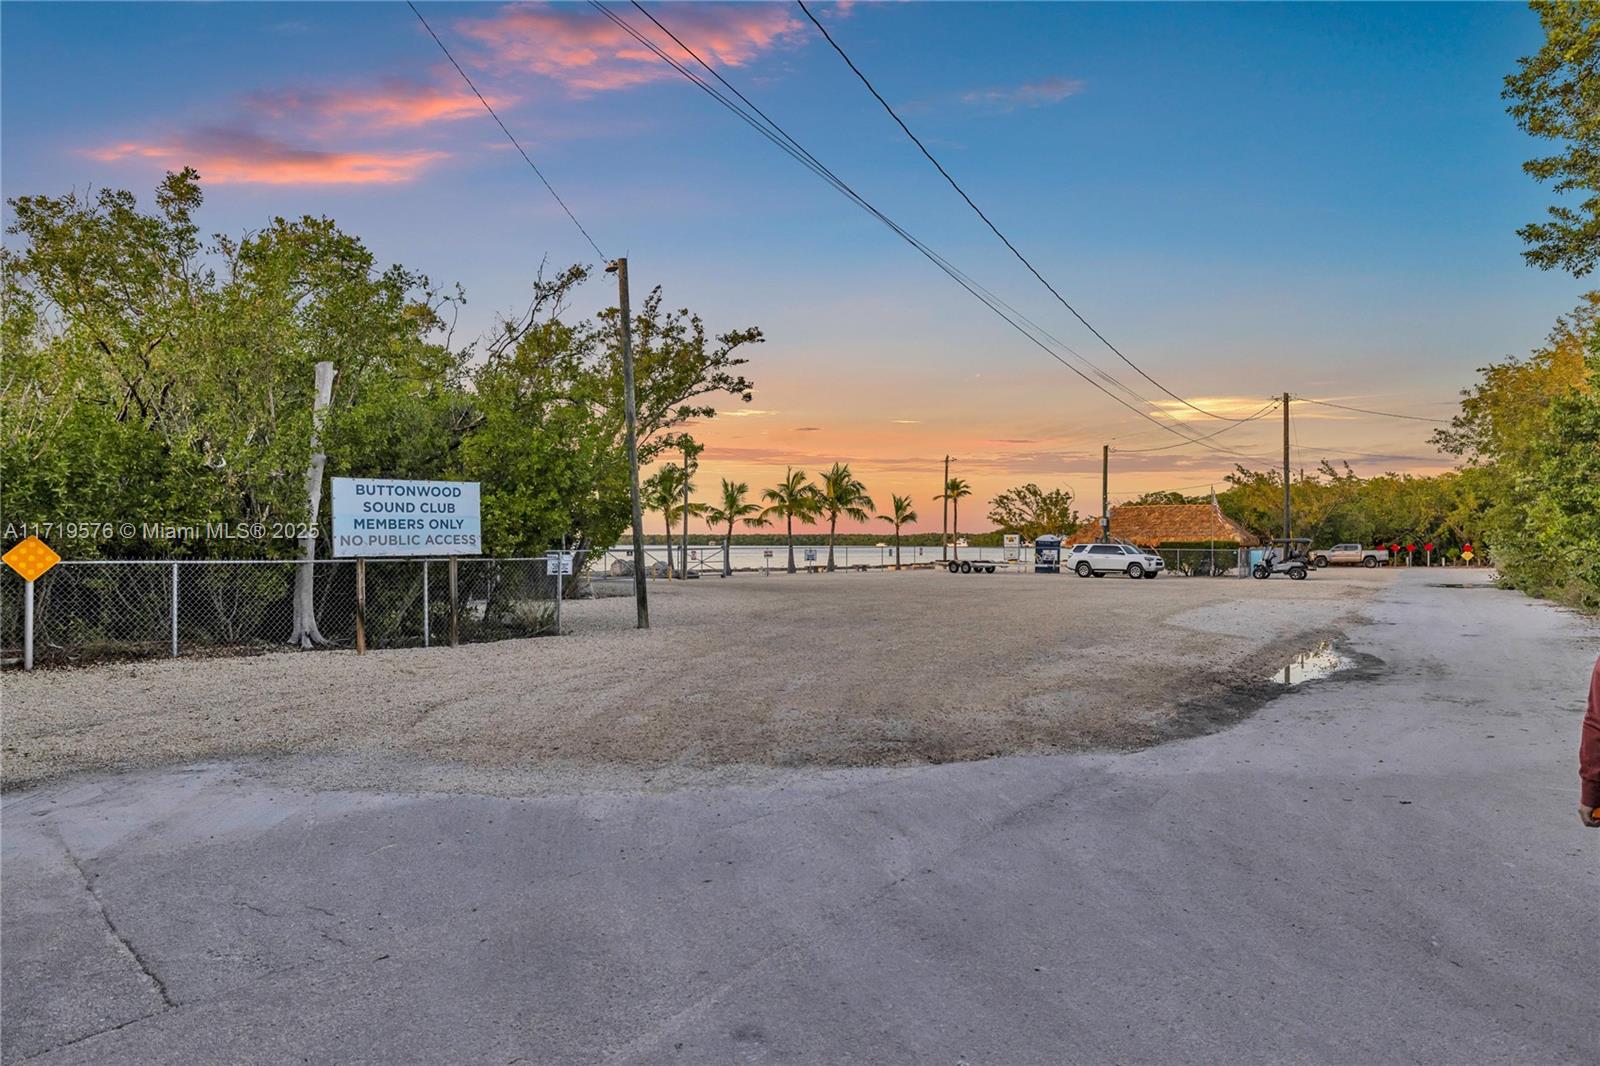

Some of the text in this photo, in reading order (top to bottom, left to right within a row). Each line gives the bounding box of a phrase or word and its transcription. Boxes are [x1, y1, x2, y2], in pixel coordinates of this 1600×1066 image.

[356, 484, 461, 497] BUTTONWOOD
[363, 502, 455, 513] SOUND CLUB
[354, 519, 464, 529] MEMBERS ONLY
[340, 534, 476, 546] NO PUBLIC ACCESS
